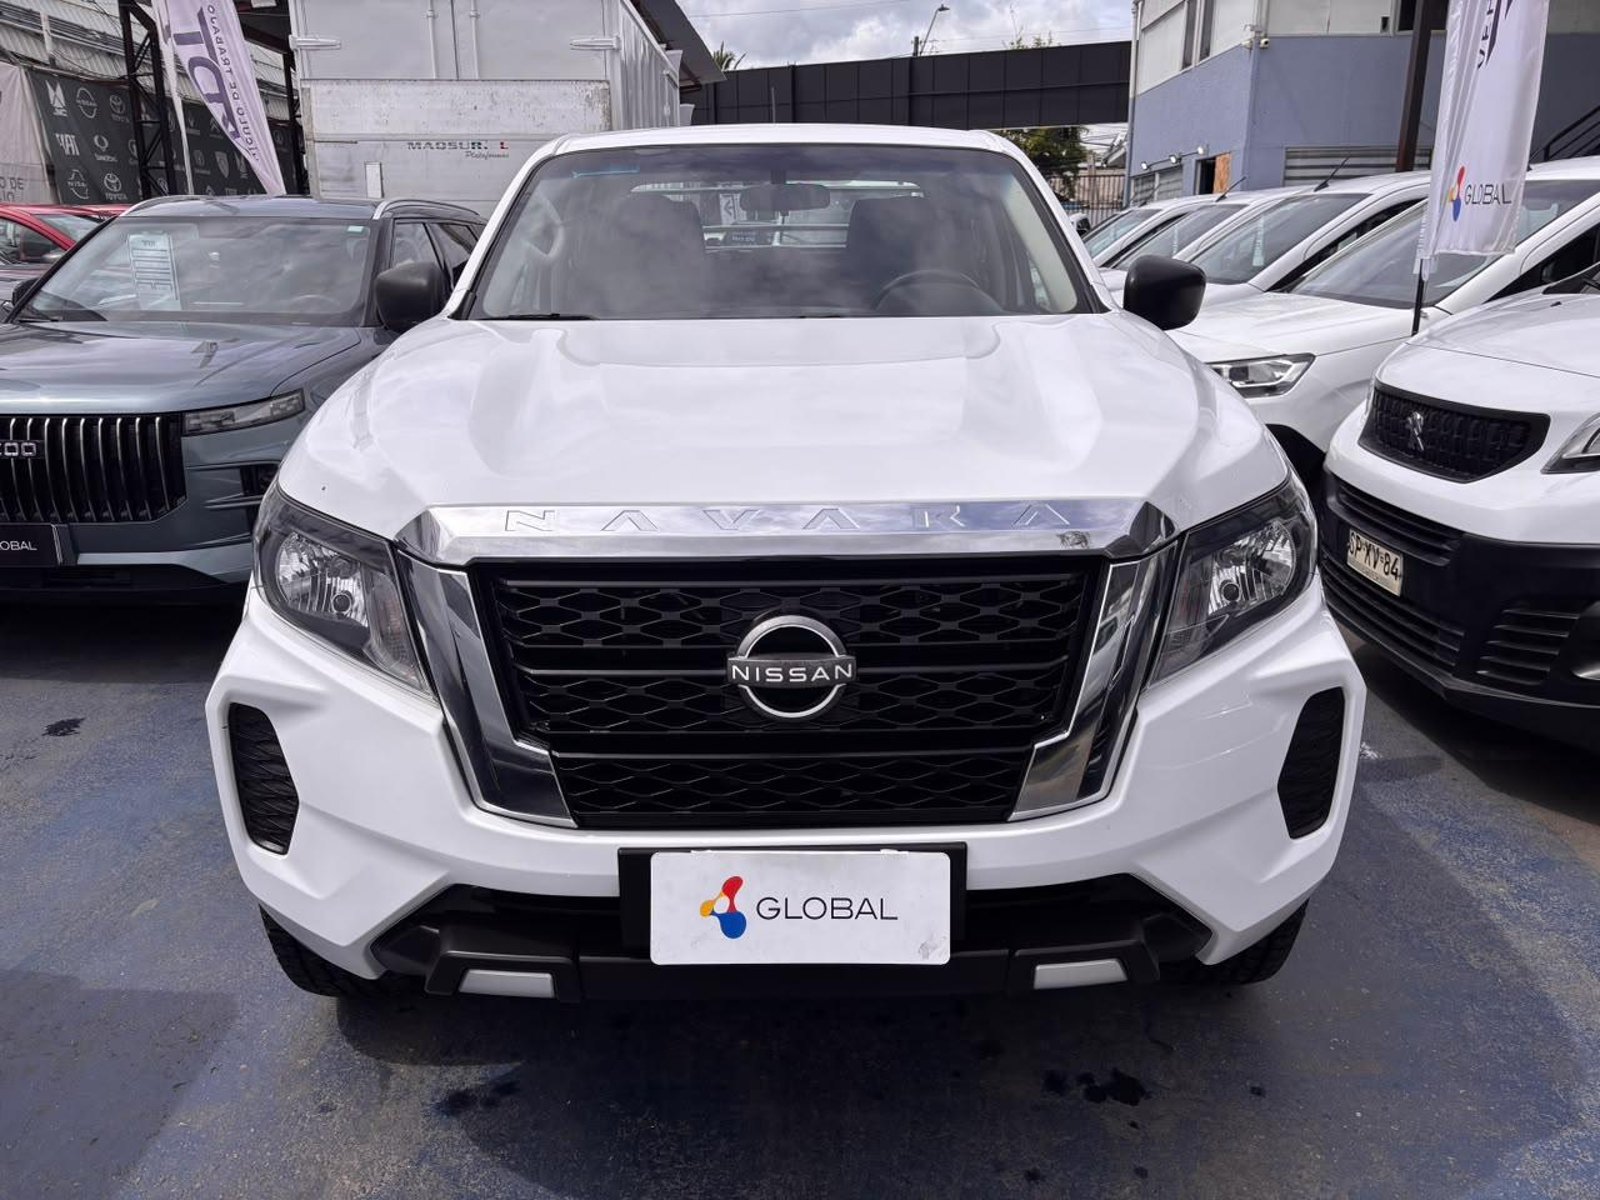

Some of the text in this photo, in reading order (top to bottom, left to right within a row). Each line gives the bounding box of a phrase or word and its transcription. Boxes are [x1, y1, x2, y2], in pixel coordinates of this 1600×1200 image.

[1464, 183, 1512, 205] GLOBAL
[504, 503, 1070, 532] NAVARA
[731, 663, 852, 682] NISSAN
[756, 896, 898, 921] GLOBAL
